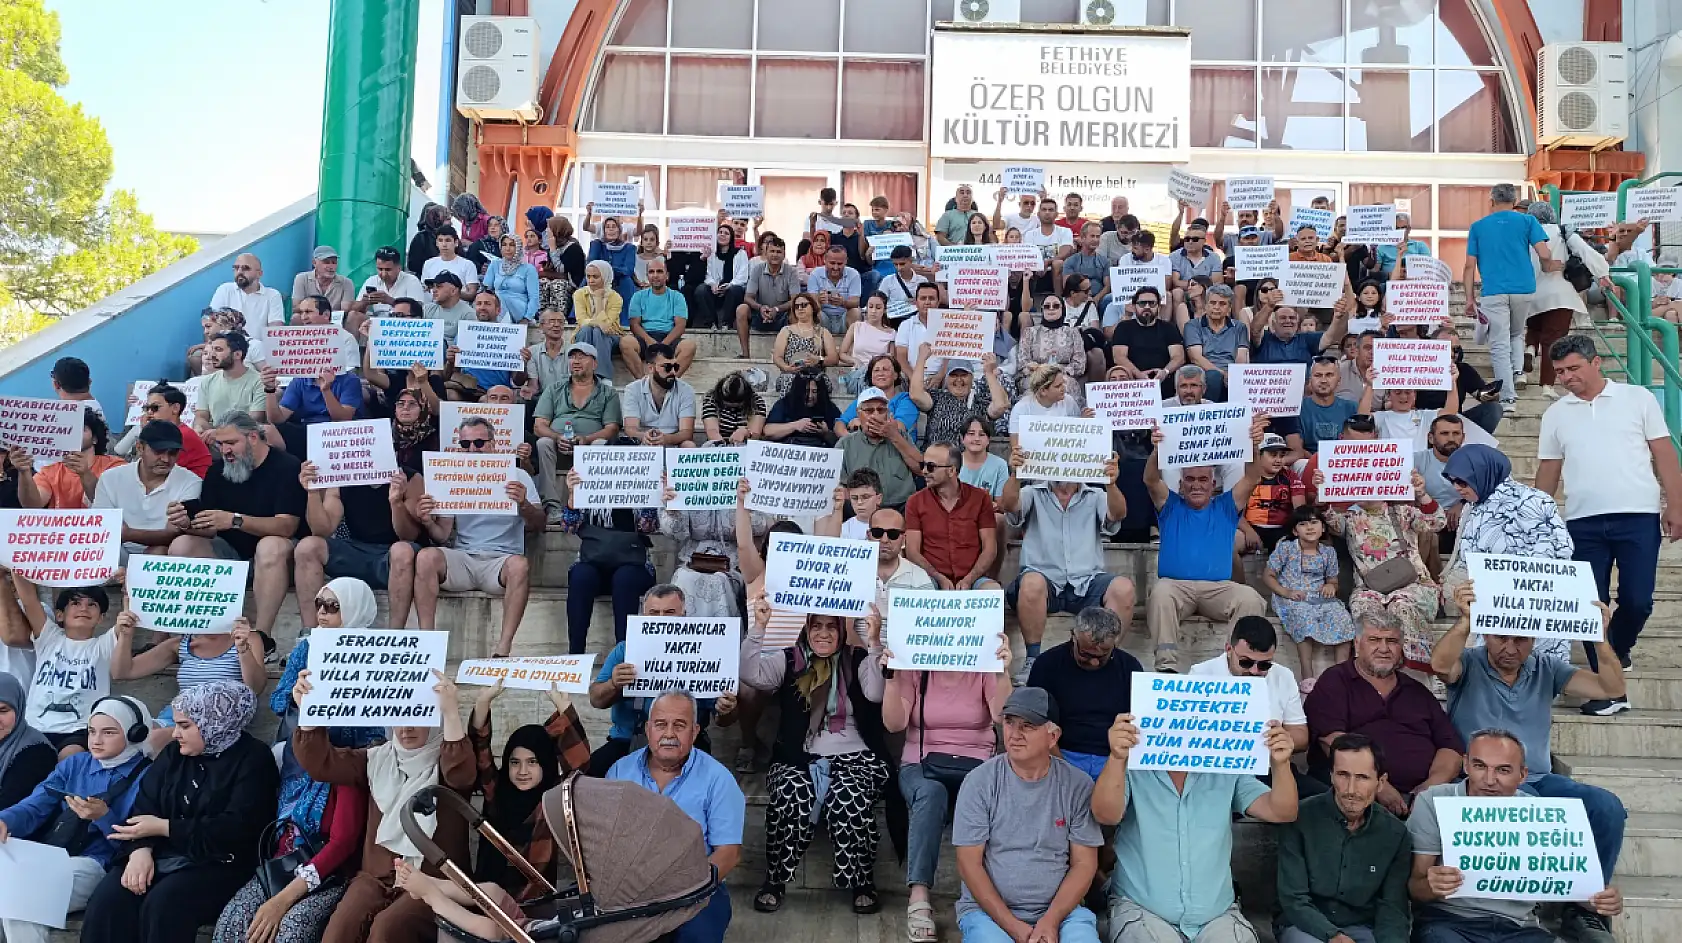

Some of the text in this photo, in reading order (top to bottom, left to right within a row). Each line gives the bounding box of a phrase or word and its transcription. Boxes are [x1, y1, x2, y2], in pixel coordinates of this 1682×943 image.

[1040, 46, 1126, 63] FETHiYE
[1040, 61, 1127, 76] BELEDiYESi
[970, 76, 1153, 114] ÖZER OLGUN
[943, 113, 1178, 148] KÜLTÜR MERKEZİ
[380, 320, 434, 328] BALIKÇILAR
[381, 329, 431, 337] DESTEKTE!
[388, 340, 439, 348] MÜCADELE
[399, 349, 435, 357] HALKIN
[1162, 406, 1245, 424] ZEYTİN ÜRETİCİSİ
[1182, 424, 1212, 436] DİYOR
[1044, 438, 1087, 449] AYAKTA!
[1178, 435, 1232, 450] ESNAF İÇİN
[1333, 443, 1397, 455] KUYUMCULAR
[582, 449, 656, 463] ÇİFTÇİLER SESSİZ
[677, 452, 739, 464] KAHVECİLER
[1167, 448, 1243, 464] BİRLİK ZAMANI!
[1328, 457, 1404, 468] DESTEĞE GELDİ!
[588, 465, 650, 476] KALMAYACAK!
[671, 468, 710, 478] SUSKUN
[1022, 465, 1060, 477] AYAKTA
[1332, 471, 1400, 482] ESNAFIN GÜCÜ
[580, 478, 659, 490] TURİZM HEPİMİZE
[674, 480, 708, 491] BUGÜN
[1324, 484, 1409, 496] BİRLİKTEN GELİR!
[435, 499, 476, 509] ELECEĞİNİ
[588, 491, 649, 505] CAN VERİYOR!
[684, 493, 736, 506] GÜNÜDÜR!
[17, 514, 102, 528] KUYUMCULAR
[7, 530, 110, 544] DESTEĞE GELDİ!
[11, 547, 104, 562] ESNAFIN GÜCÜ
[776, 540, 872, 559] ZEYTİN ÜRETİCİSİ
[142, 560, 232, 575] KASAPLAR DA
[795, 557, 831, 573] DİYOR
[1483, 559, 1577, 576] RESTORANCILAR
[11, 564, 113, 582] İRLİKTEN GELİR!
[156, 575, 216, 587] BURADA!
[789, 575, 852, 594] ESNAF İÇİN
[1513, 578, 1553, 592] YAKTA!
[131, 586, 238, 603] TURİZM BİTERSE
[773, 590, 864, 611] BİRLİK ZAMANI!
[141, 601, 227, 616] ESNAF NEFES
[893, 596, 1000, 612] EMLAKÇILAR SESSİZ
[1493, 594, 1579, 612] VİLLA TURİZMİ
[154, 616, 211, 629] ALAMAZ!
[641, 621, 726, 635] RESTORANCILAR
[914, 615, 976, 628] KALMIYOR!
[1475, 612, 1598, 634] HEPİMİZİN EKMEĞİ!
[336, 634, 418, 648] SERACILAR
[906, 632, 984, 646] HEPİMİZ AYNI
[664, 641, 702, 655] YAKTA!
[322, 651, 430, 664] YALNIZ DEĞİL!
[912, 651, 978, 666] GEMİDEYİZ!
[645, 657, 721, 674] VİLLA TURİZMİ
[319, 667, 431, 682] VİLLA TURİZMİ
[330, 685, 414, 700] HEPİMİZİN
[688, 677, 735, 694] EKMEĞİ!
[1151, 678, 1251, 697] BALIKÇILAR
[307, 702, 435, 720] GEÇİM KAYNAĞI!
[1156, 697, 1248, 714] DESTEKTE!
[1140, 715, 1263, 734] BU MÜCADELE
[1146, 732, 1254, 751] TÜM HALKIN
[1139, 750, 1257, 770] MÜCADELESİ!
[1461, 803, 1567, 823] KAHVECİLER
[1452, 828, 1583, 847] SUSKUN DEĞİL!
[1460, 851, 1587, 873] BUGÜN BİRLİK
[1476, 876, 1573, 895] GÜNÜDÜR!
